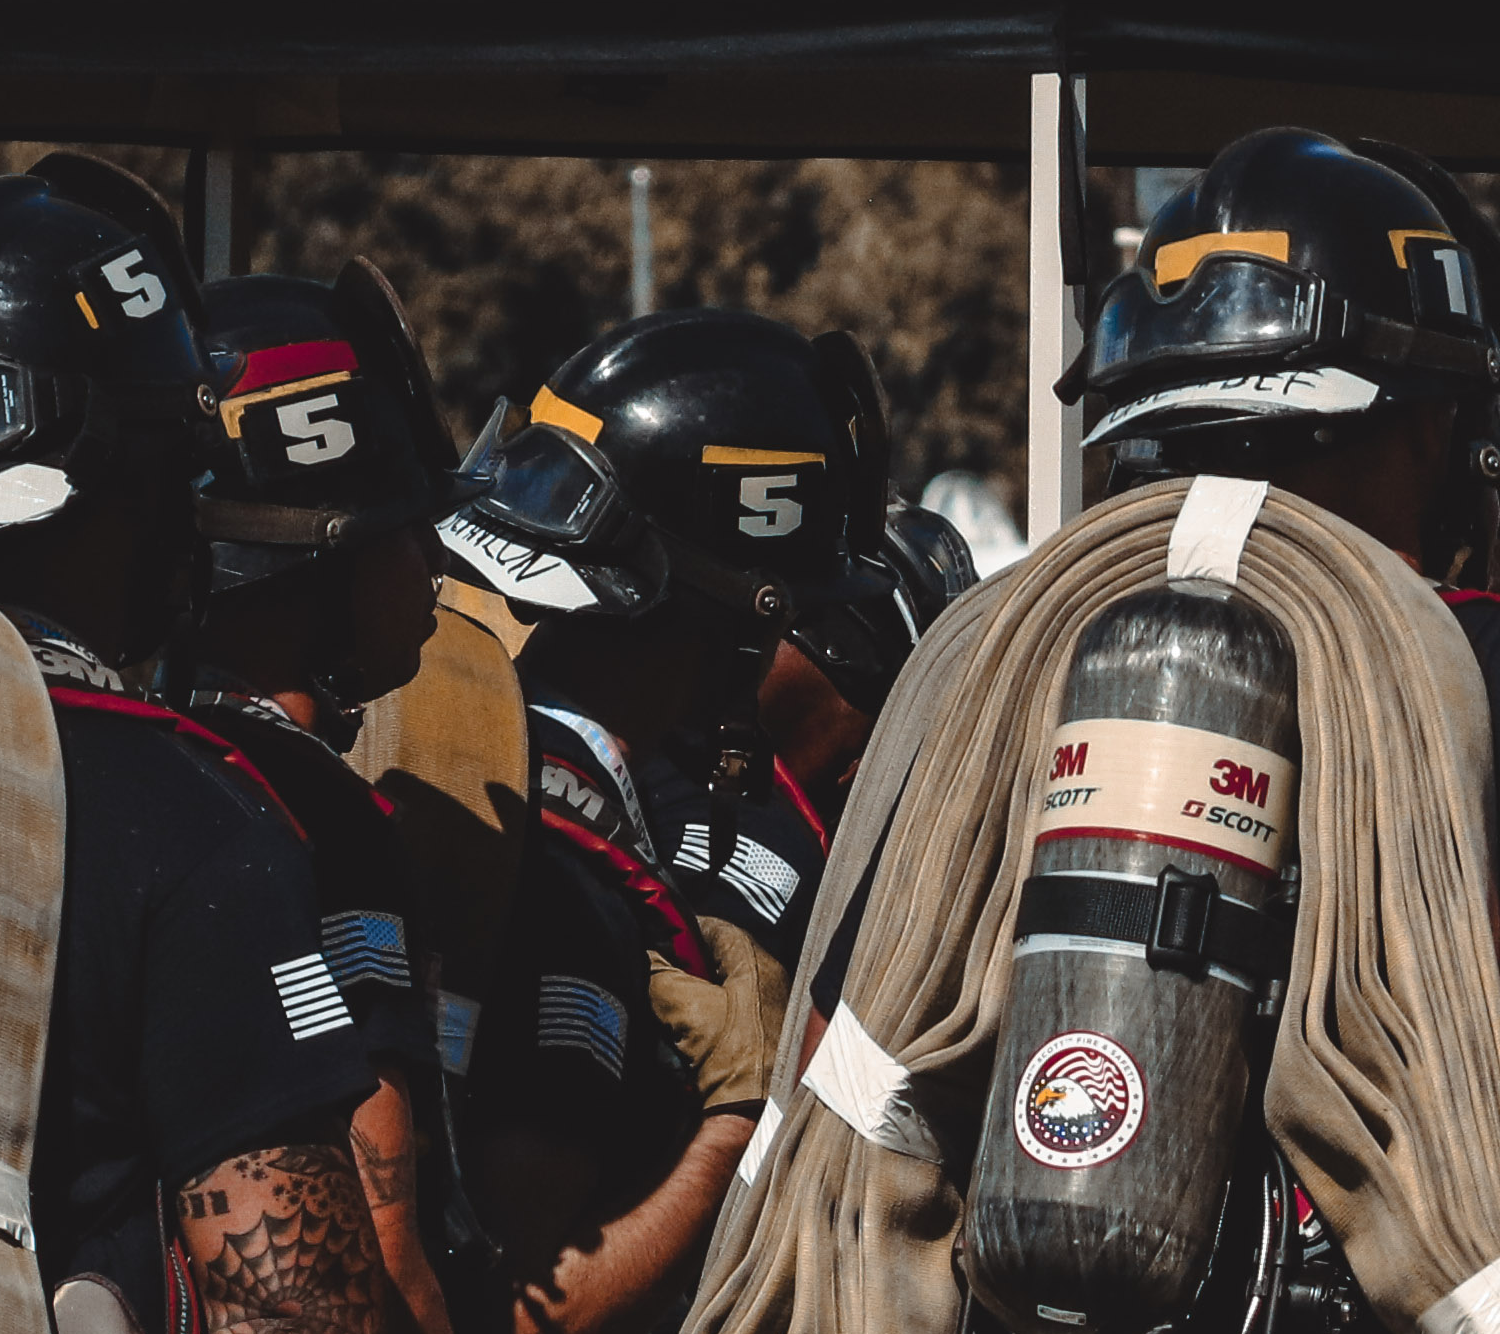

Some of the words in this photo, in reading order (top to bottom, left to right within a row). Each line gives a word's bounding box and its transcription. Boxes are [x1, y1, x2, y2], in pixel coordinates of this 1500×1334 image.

[100, 248, 168, 319] 5
[1432, 248, 1468, 316] 1
[274, 393, 356, 466] 5
[737, 472, 804, 539] 5
[1050, 740, 1090, 779] 3M
[1209, 757, 1270, 809] 3M
[1205, 806, 1276, 844] SCOTT
